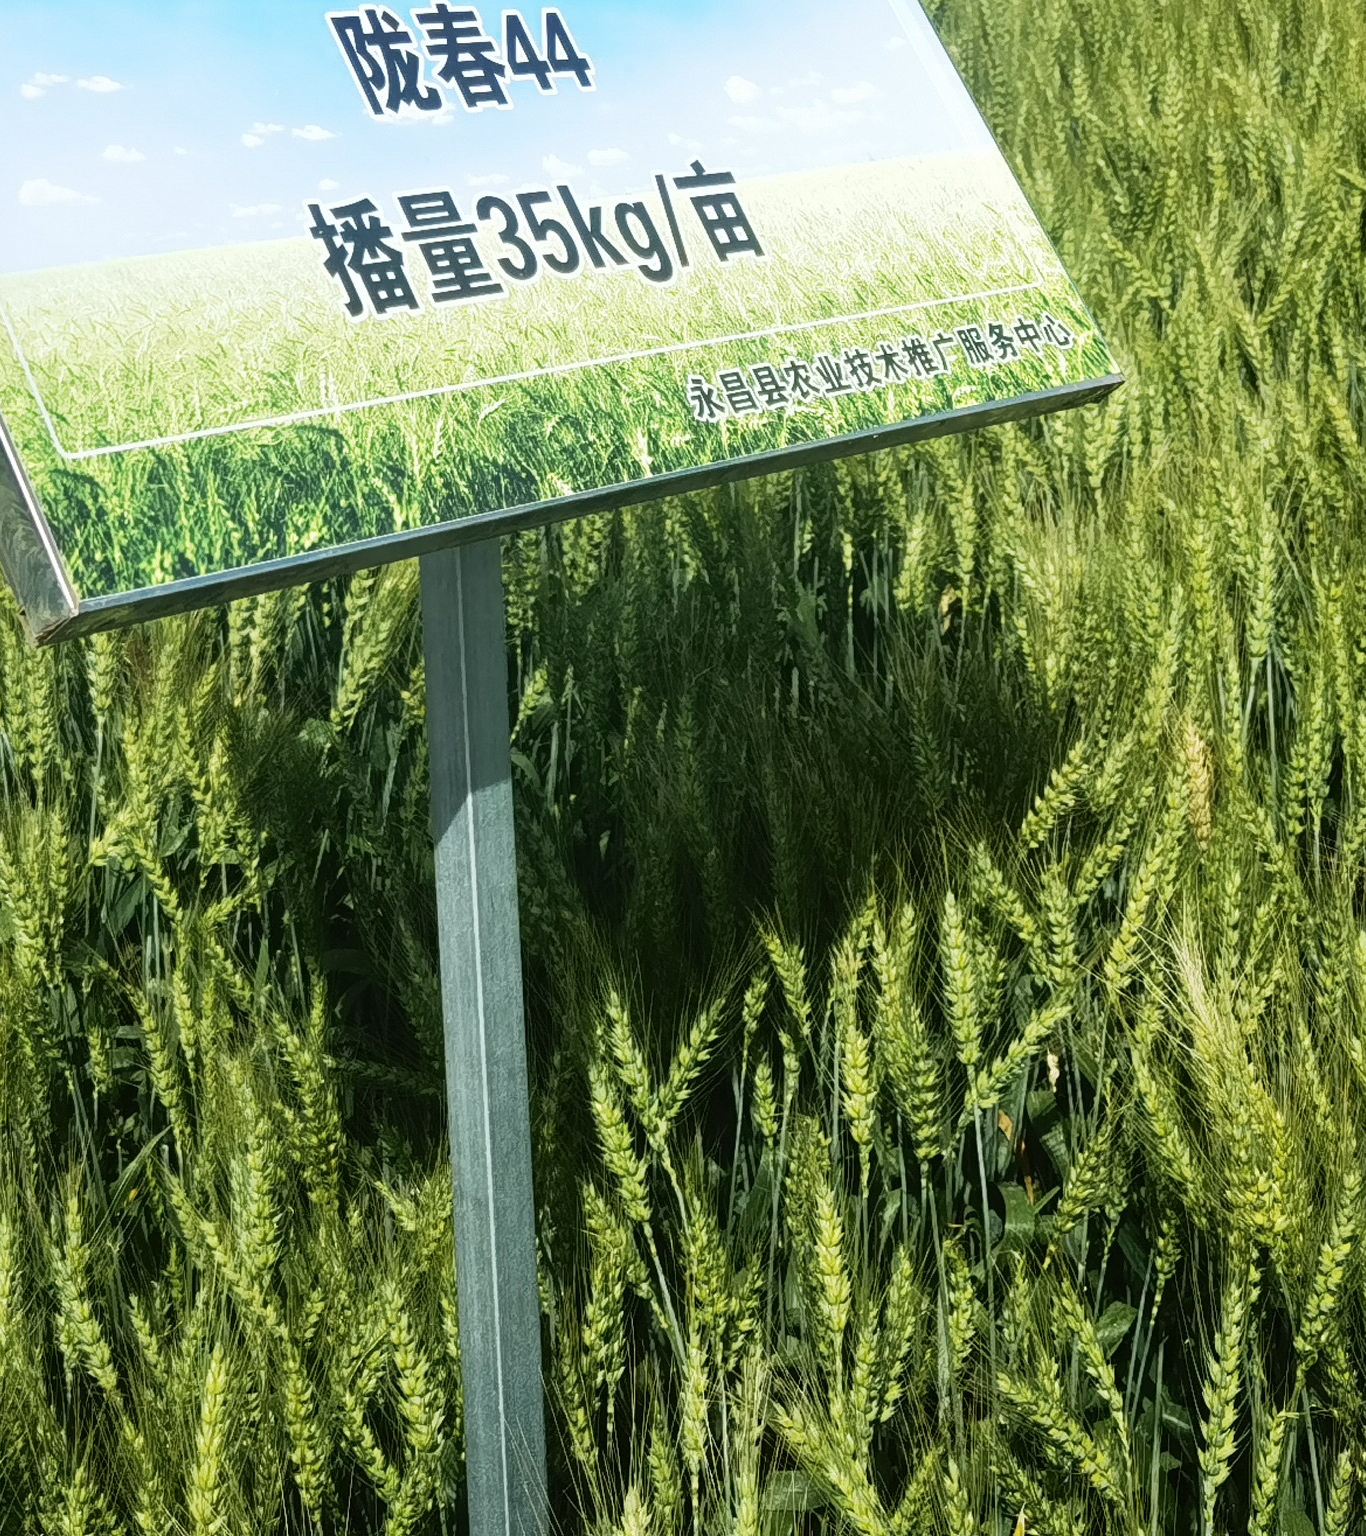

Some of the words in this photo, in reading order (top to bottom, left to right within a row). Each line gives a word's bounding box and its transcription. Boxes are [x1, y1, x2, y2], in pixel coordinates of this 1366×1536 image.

[329, 2, 594, 116] 陇春44
[309, 160, 765, 318] 播量35kg/亩
[687, 314, 1073, 420] 永昌县农业技术推广服务中心
